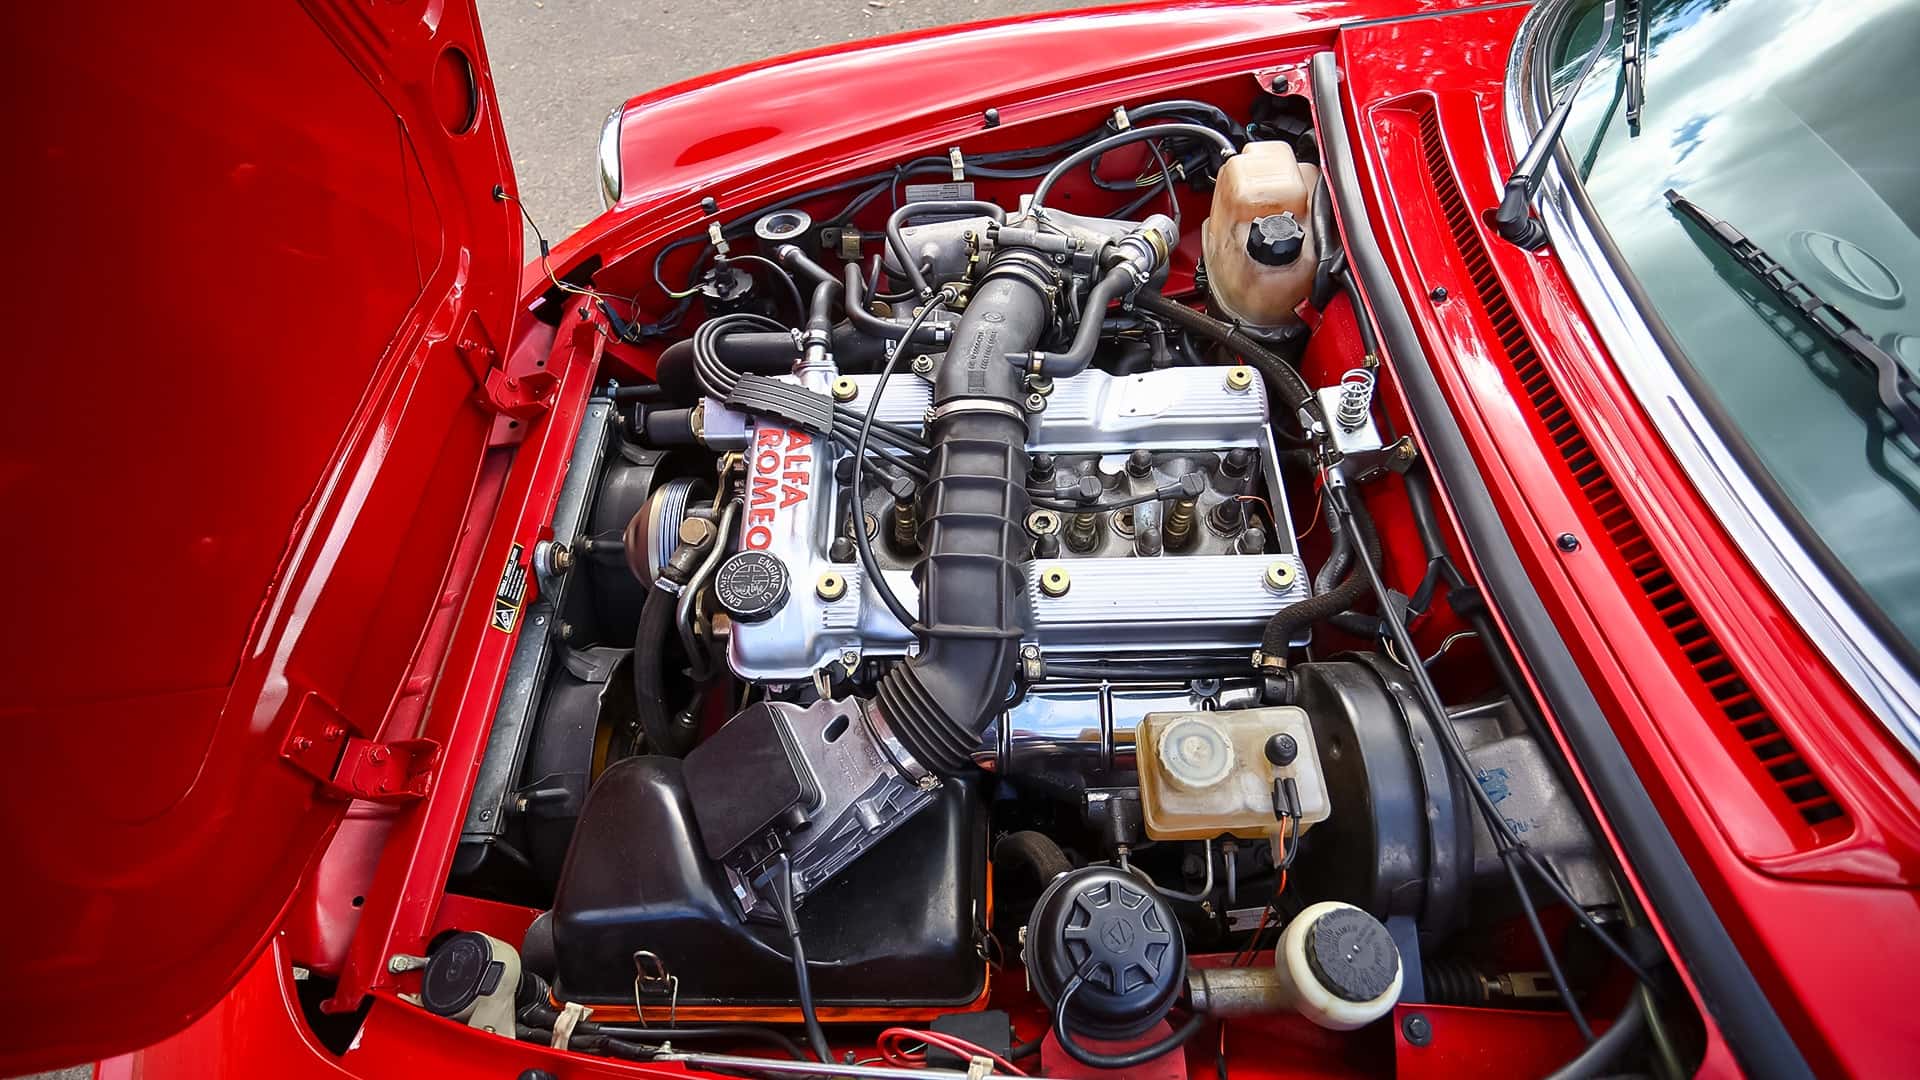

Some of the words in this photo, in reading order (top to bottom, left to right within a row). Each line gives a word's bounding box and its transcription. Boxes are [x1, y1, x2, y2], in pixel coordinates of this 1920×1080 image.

[746, 429, 784, 550] ROMEO
[780, 429, 812, 509] ALFA
[728, 558, 746, 571] OIL
[757, 556, 780, 589] ENGINE
